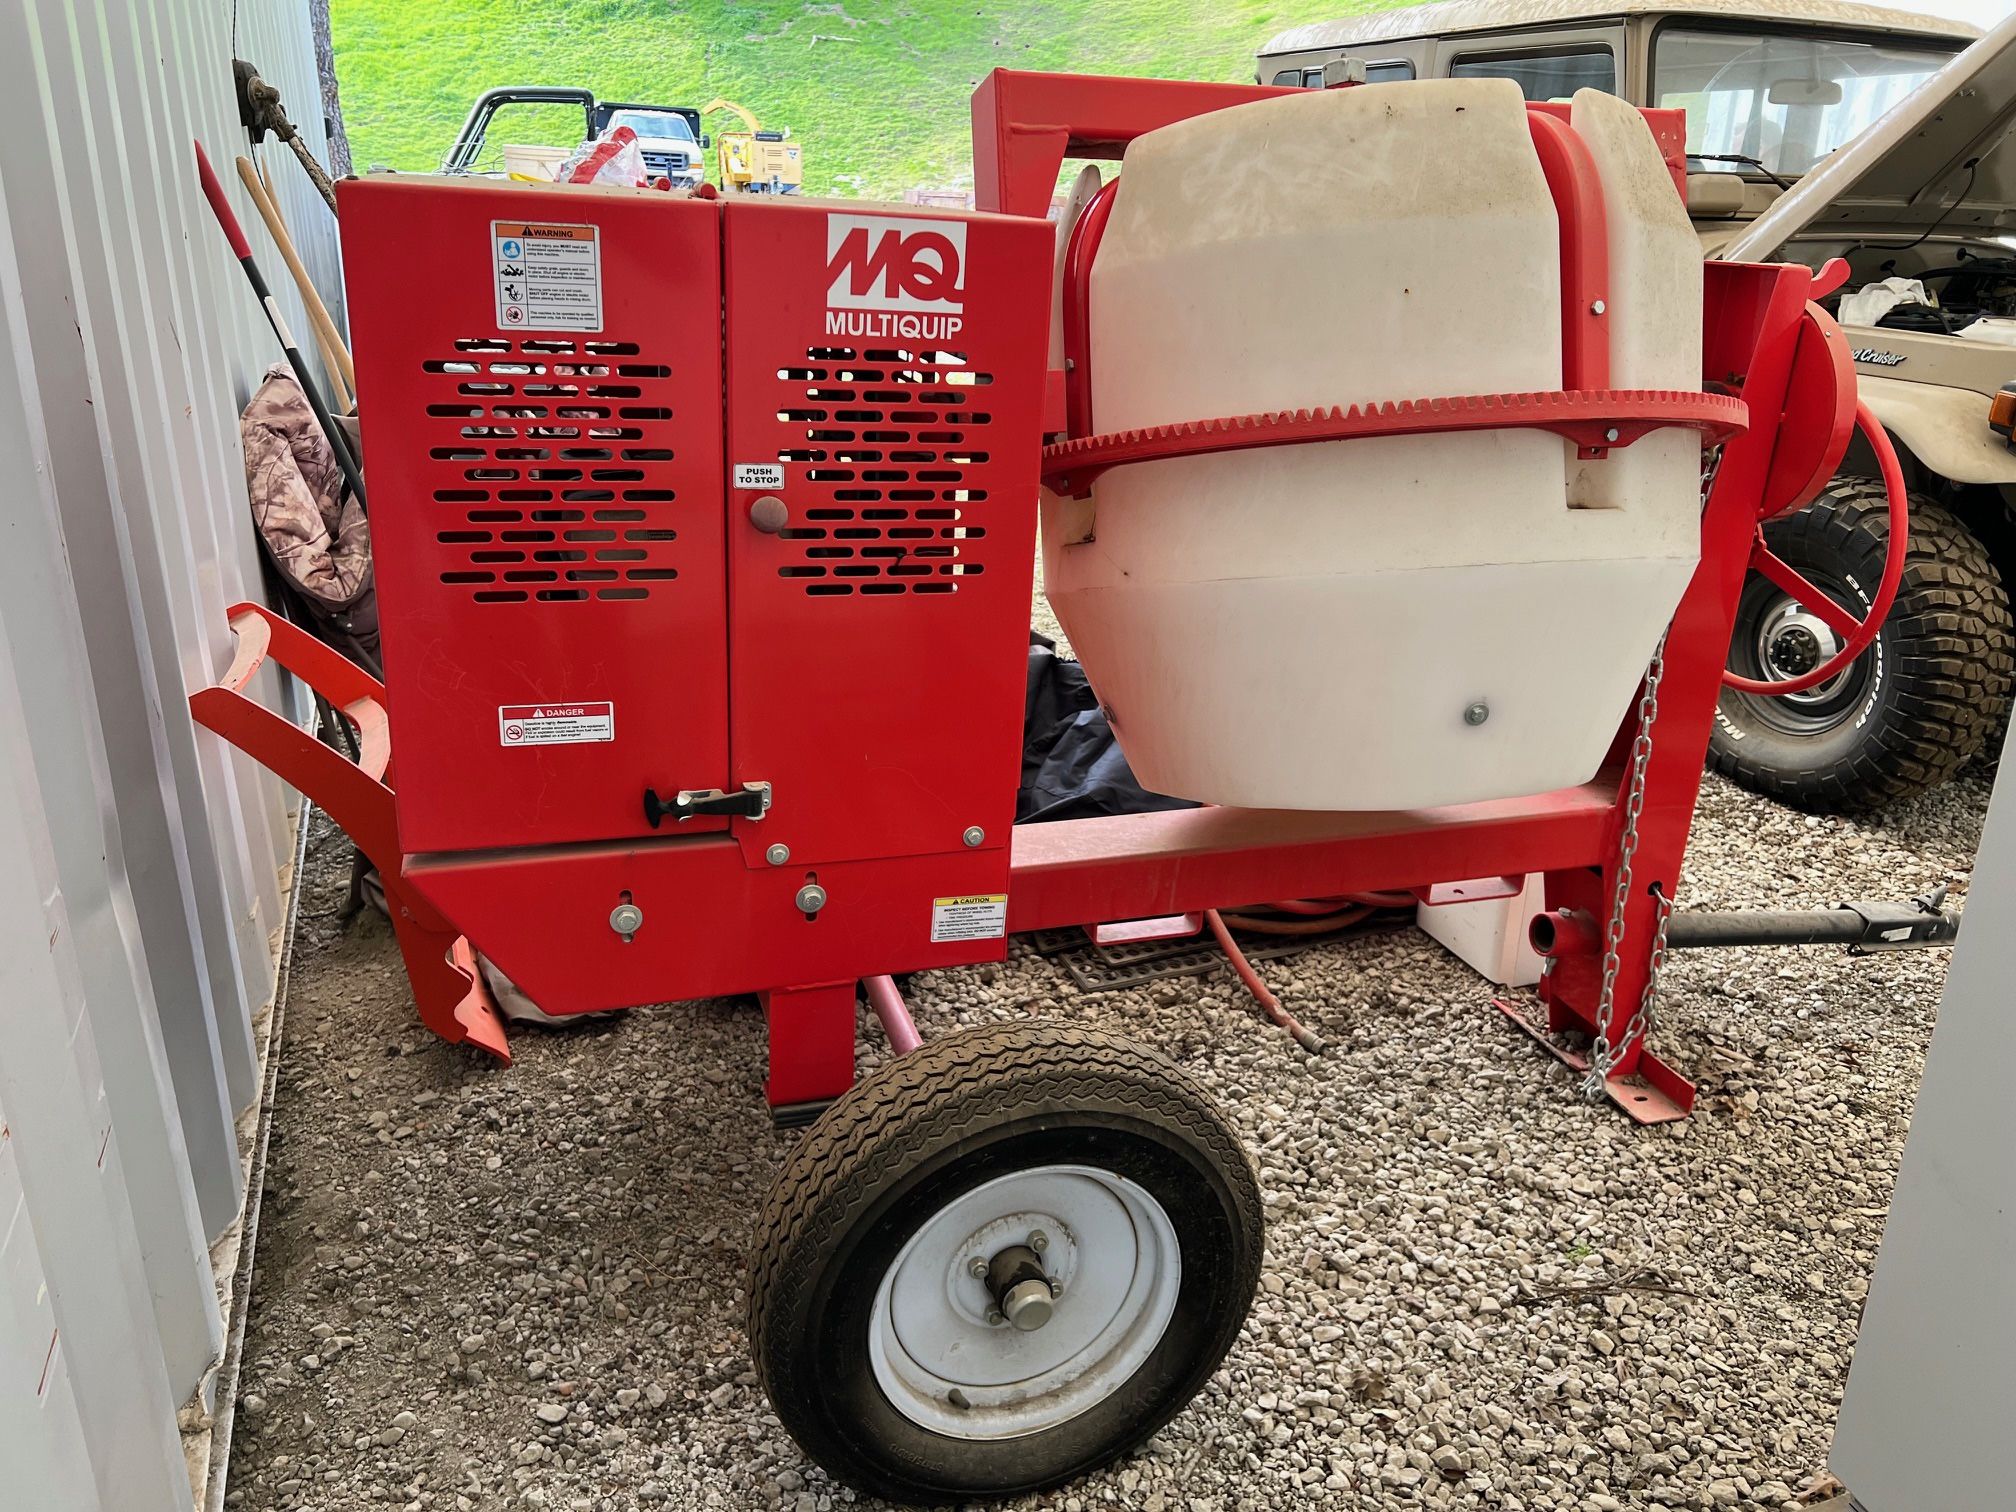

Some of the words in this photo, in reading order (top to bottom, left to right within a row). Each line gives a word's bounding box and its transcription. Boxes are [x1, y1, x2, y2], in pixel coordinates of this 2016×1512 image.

[533, 229, 574, 238] WARNING
[827, 226, 966, 304] MQ
[825, 311, 963, 340] MULTIQUIP
[1860, 348, 1908, 367] Cruiser
[754, 476, 780, 484] STOP
[546, 708, 585, 717] DANGER
